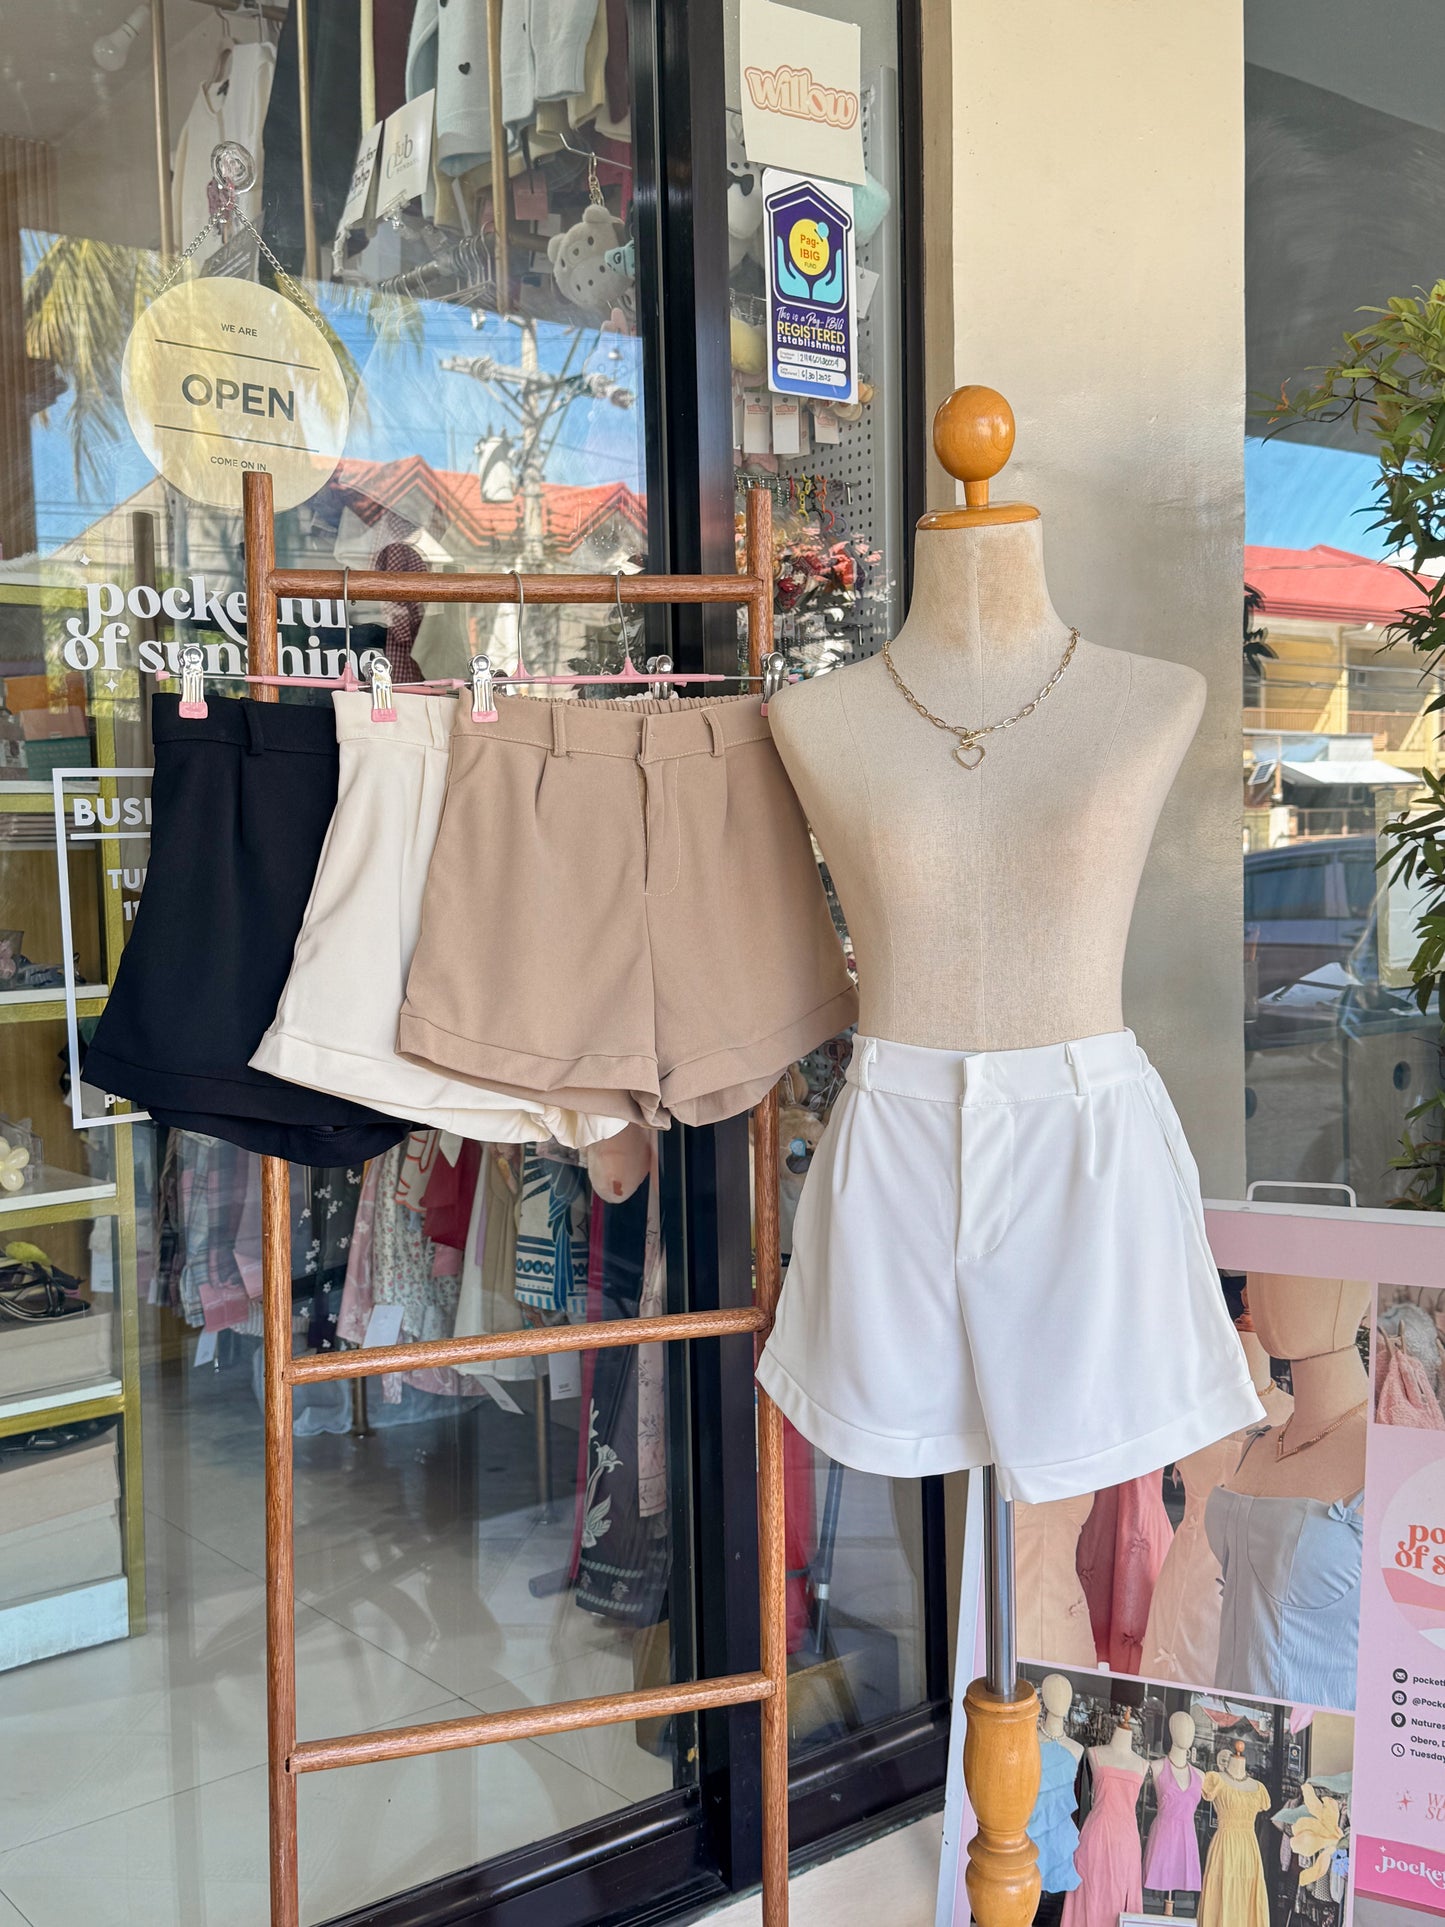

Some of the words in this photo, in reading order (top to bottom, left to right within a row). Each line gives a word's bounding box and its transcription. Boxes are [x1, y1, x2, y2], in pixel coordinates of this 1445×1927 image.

[745, 65, 858, 130] willow
[800, 234, 820, 249] Pag-
[800, 248, 821, 261] IBIG
[776, 306, 791, 321] This
[792, 313, 799, 322] is
[221, 323, 236, 334] WE
[238, 326, 258, 337] ARE
[777, 320, 846, 345] REGISTERED
[777, 334, 846, 353] Establishment
[181, 373, 295, 422] OPEN
[210, 456, 239, 468] COME
[240, 460, 255, 471] ON
[257, 462, 267, 472] IN
[64, 622, 130, 671] of
[107, 868, 147, 890] TU
[1395, 1545, 1430, 1570] of
[1411, 1718, 1445, 1730] Natures
[1410, 1735, 1440, 1747] Obero,
